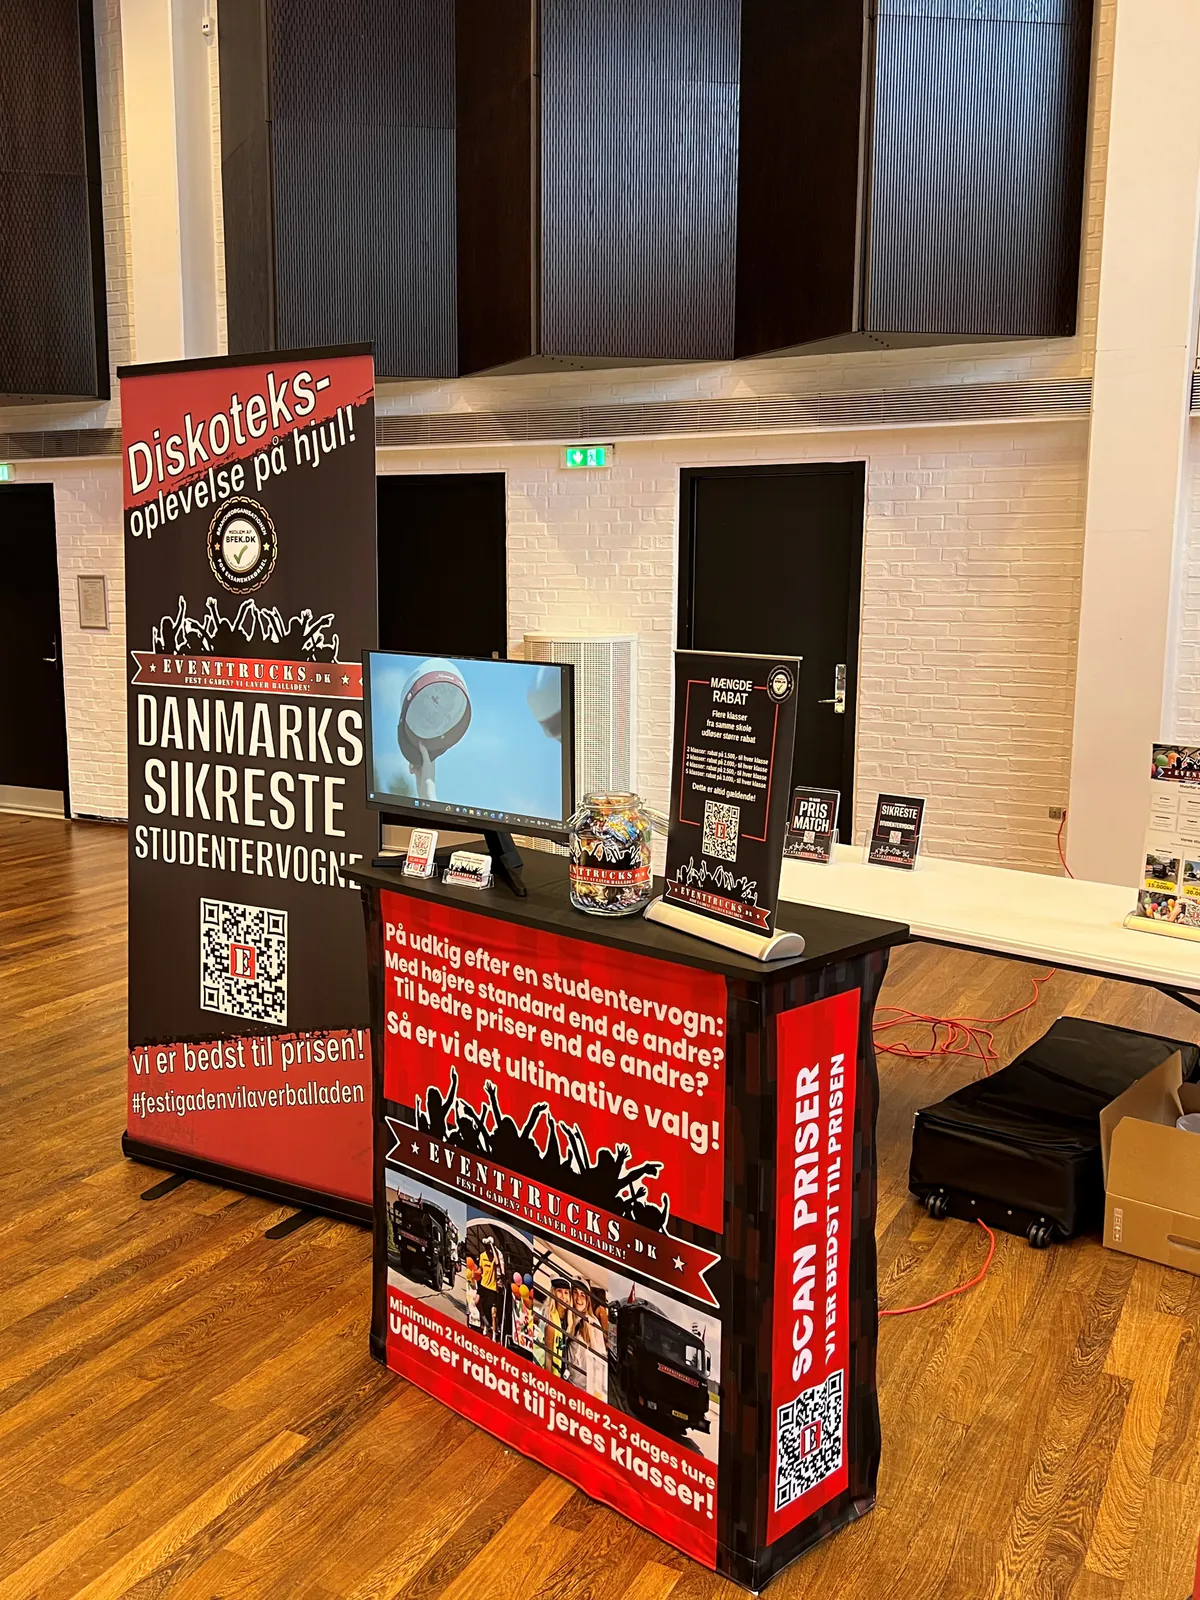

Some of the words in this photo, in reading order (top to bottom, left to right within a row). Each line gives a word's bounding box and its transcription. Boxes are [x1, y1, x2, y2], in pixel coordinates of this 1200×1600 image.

[128, 370, 331, 495] Diskoteks-
[130, 463, 245, 539] oplevelse
[254, 435, 287, 492] på
[293, 404, 356, 469] hjul!
[226, 535, 256, 543] BFEK.DK
[217, 558, 226, 572] FOR
[185, 676, 201, 684] FEST
[209, 677, 233, 687] GADEN?
[236, 679, 243, 687] VI
[245, 680, 269, 689] LAVER
[272, 681, 310, 692] BALLADEN!
[711, 677, 753, 691] MÆNGDE
[713, 690, 748, 705] RABAT
[137, 693, 363, 767] DANMARKS
[701, 729, 722, 739] udløser
[723, 732, 739, 741] større
[740, 734, 756, 744] rabat
[706, 719, 715, 727] fra
[715, 722, 735, 731] samme
[736, 723, 752, 733] skole
[712, 709, 726, 718] Flere
[727, 711, 748, 721] klasser
[144, 758, 346, 838] SIKRESTE
[692, 782, 706, 792] Dette
[714, 787, 726, 796] altid
[726, 790, 756, 802] gældende!
[799, 801, 828, 819] PRIS
[881, 805, 918, 819] SIKRESTE
[793, 815, 830, 833] MATCH
[385, 922, 407, 947] På
[409, 933, 461, 969] udkig
[464, 948, 510, 977] efter
[513, 964, 539, 987] en
[541, 972, 724, 1038] studentervogn:
[385, 949, 418, 977] Med
[421, 960, 475, 992] højere
[478, 983, 565, 1024] standard
[569, 1010, 608, 1037] end
[612, 1020, 639, 1046] de
[642, 1032, 725, 1070] andre?
[132, 1046, 150, 1075] vi
[156, 1051, 177, 1075] er
[184, 1041, 246, 1073] bedst
[251, 1036, 273, 1068] til
[281, 1030, 365, 1072] prisen!
[394, 976, 415, 1001] Til
[418, 983, 473, 1021] bedre
[476, 1007, 537, 1042] priser
[540, 1028, 582, 1058] end
[586, 1040, 616, 1068] de
[620, 1054, 709, 1097] andre?
[132, 1080, 365, 1119] #festigadenvilaverballaden
[387, 1010, 412, 1040] Så
[415, 1024, 437, 1048] er
[440, 1030, 460, 1058] vi
[464, 1039, 501, 1073] det
[505, 1056, 639, 1121] ultimative
[644, 1104, 720, 1156] valg!
[828, 1053, 845, 1154] PRISEN
[794, 1062, 820, 1231] PRISER
[826, 1156, 841, 1200] TIL
[456, 1176, 477, 1193] FEST
[479, 1186, 484, 1196] I
[486, 1188, 521, 1212] GADEN?
[523, 1206, 533, 1218] VI
[536, 1211, 566, 1234] LAVER
[570, 1226, 627, 1260] BALLADEN!
[826, 1205, 840, 1292] BEDST
[792, 1243, 817, 1382] SCAN
[825, 1292, 837, 1330] ER
[825, 1330, 836, 1365] VI
[389, 1296, 444, 1336] Minimum
[445, 1326, 452, 1341] 2
[454, 1331, 499, 1366] klasser
[501, 1356, 520, 1379] fra
[521, 1372, 566, 1406] skolen
[568, 1398, 601, 1423] eller
[602, 1414, 628, 1440] 2-3
[630, 1432, 679, 1470] dages
[681, 1459, 716, 1490] ture
[389, 1313, 460, 1368] Udløser
[463, 1357, 520, 1405] rabat
[523, 1386, 545, 1419] til
[547, 1400, 606, 1454] jeres
[610, 1436, 714, 1520] klasser!
